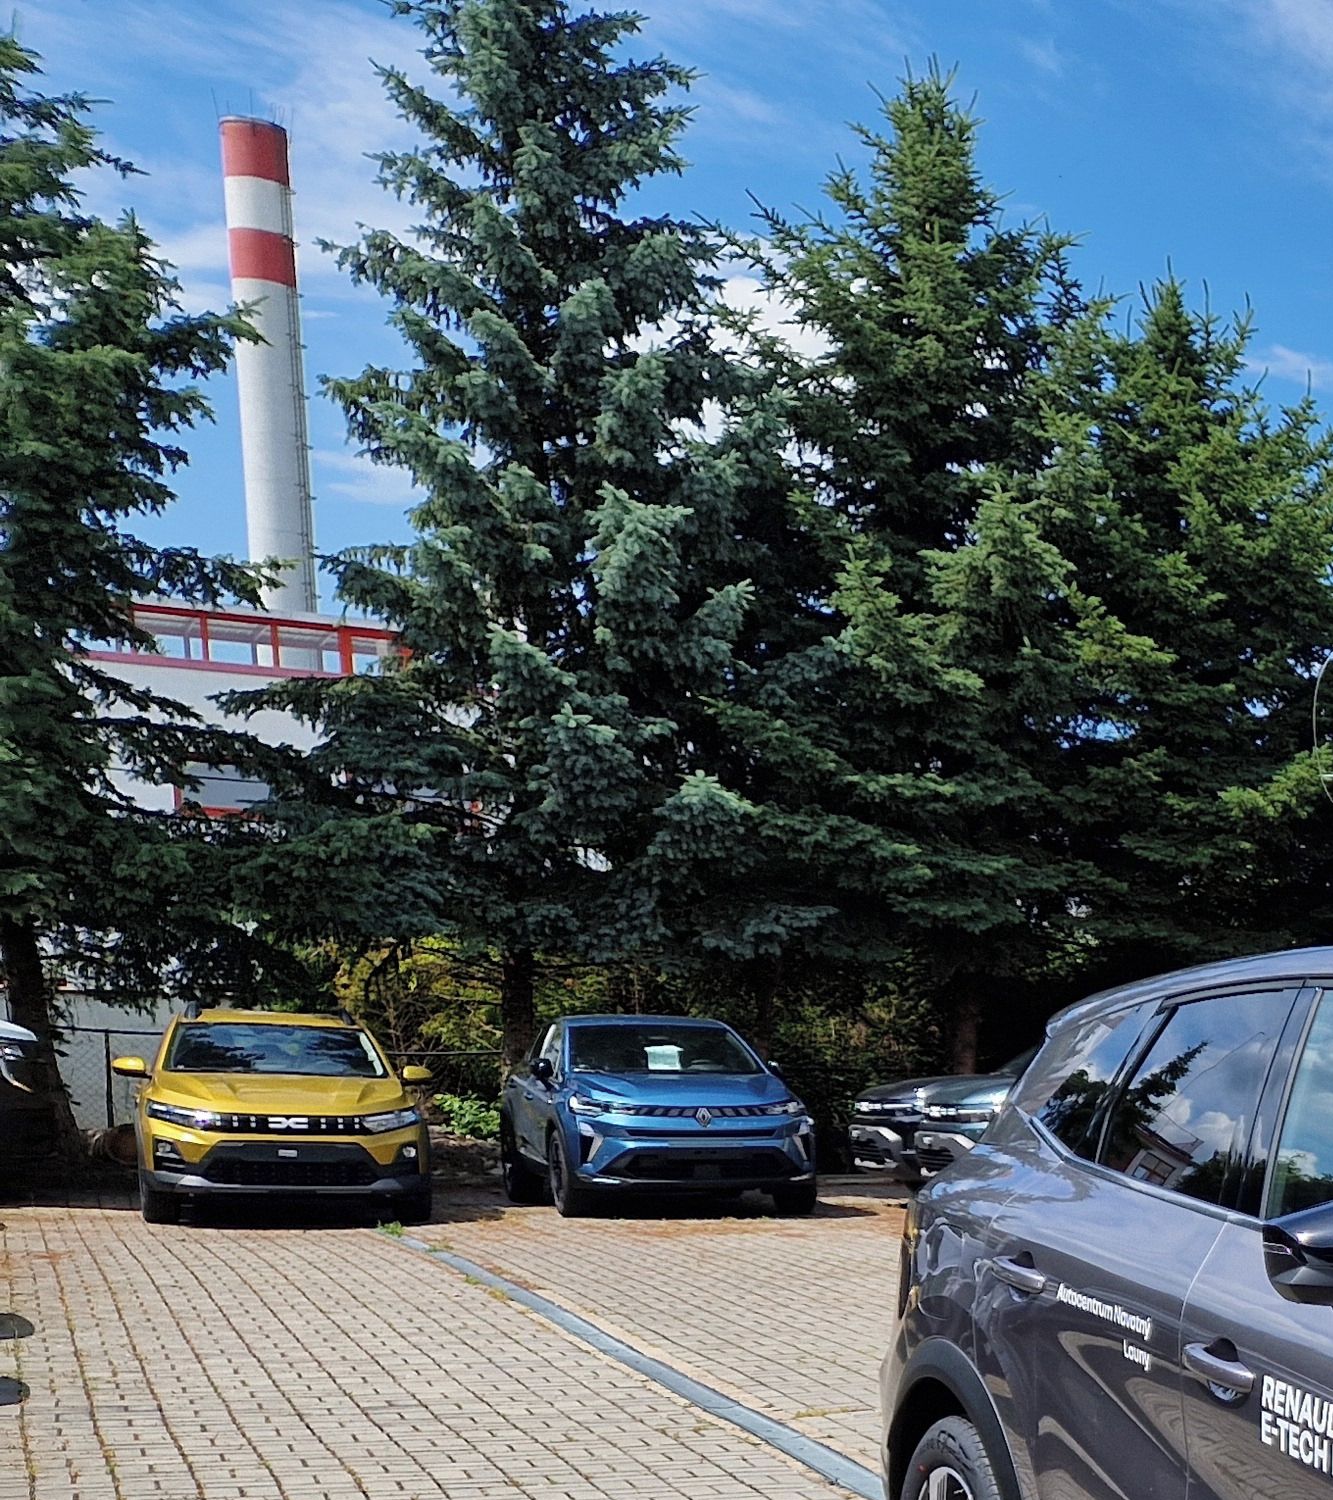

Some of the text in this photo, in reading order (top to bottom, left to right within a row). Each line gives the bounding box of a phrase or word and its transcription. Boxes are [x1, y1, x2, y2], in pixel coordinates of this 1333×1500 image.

[1056, 1282, 1151, 1341] Autocentrum Novotný
[1122, 1339, 1151, 1372] Louny
[1261, 1411, 1328, 1474] E-TECH
